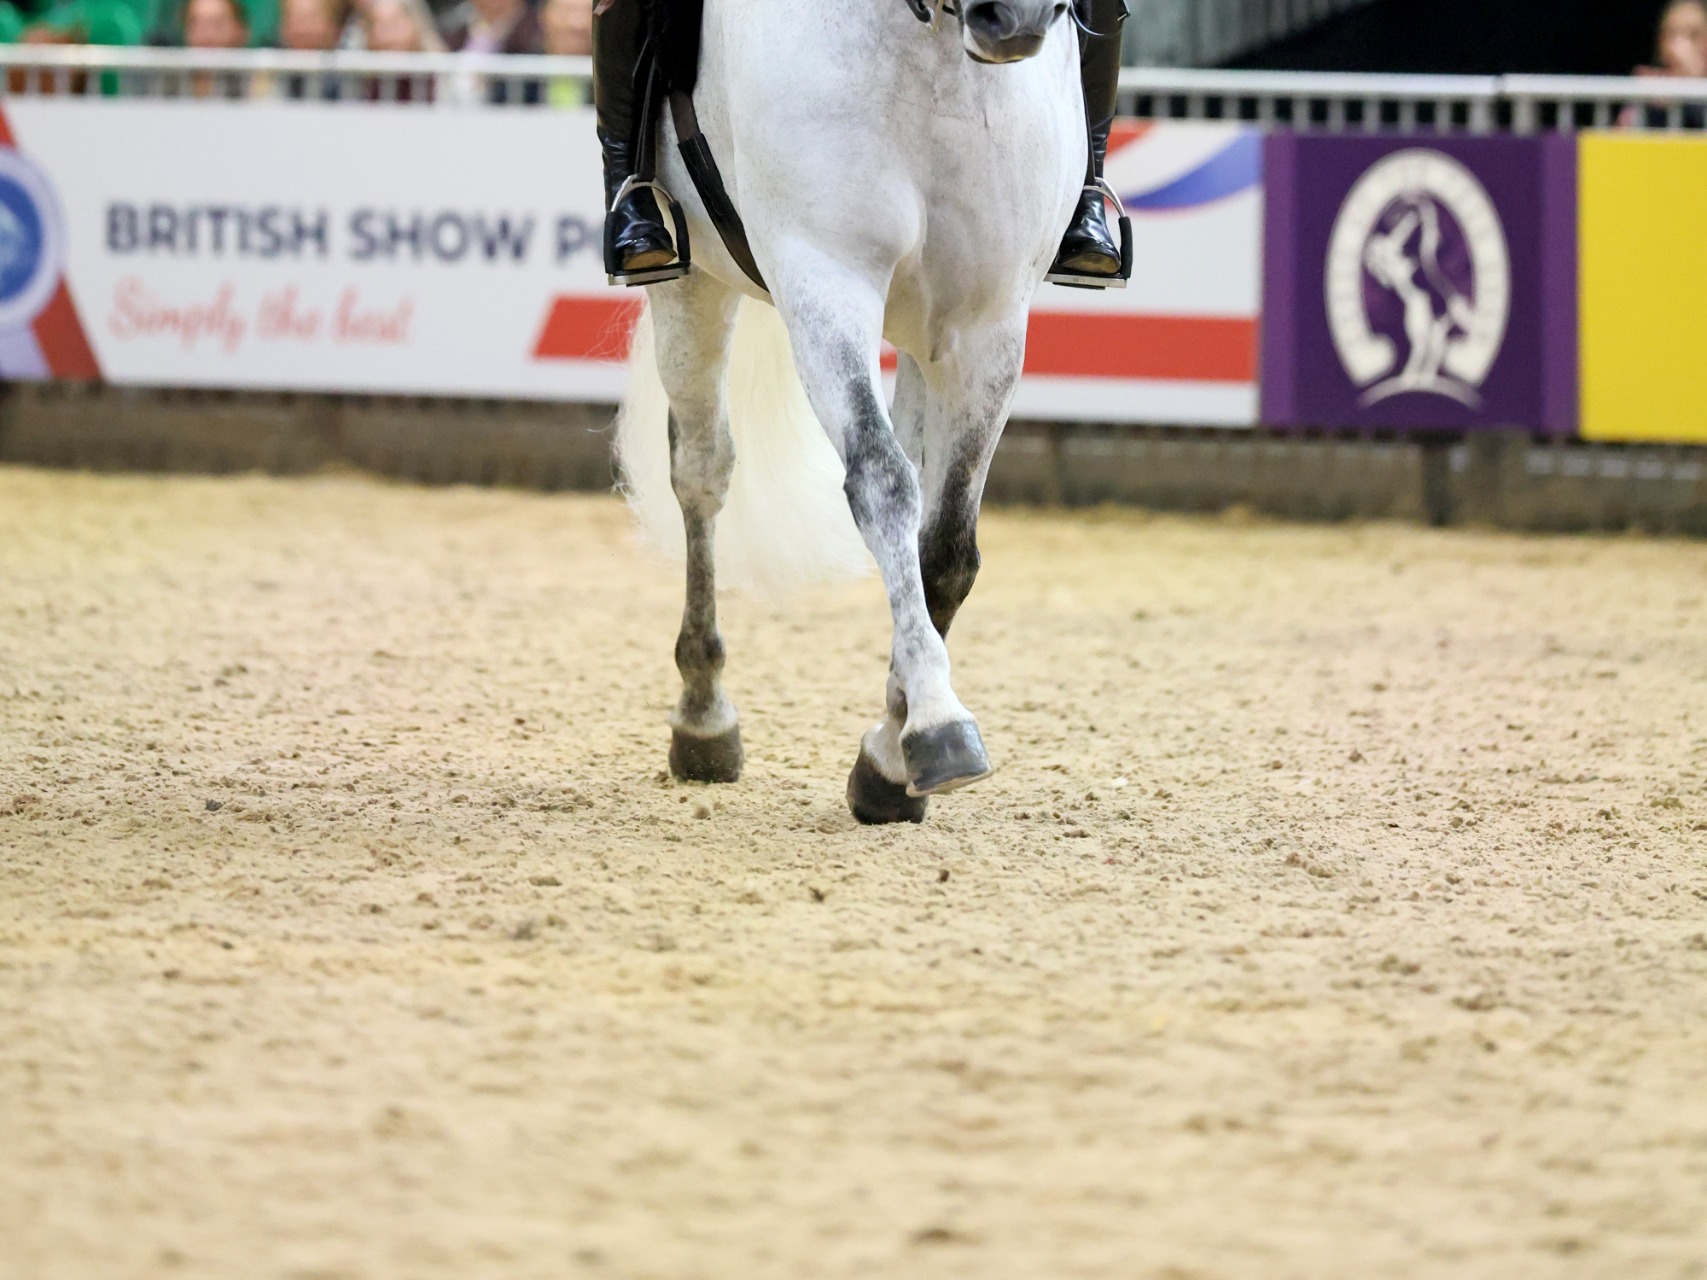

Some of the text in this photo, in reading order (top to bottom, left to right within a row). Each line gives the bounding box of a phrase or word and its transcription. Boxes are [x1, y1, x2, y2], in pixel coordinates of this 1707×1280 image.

[105, 201, 604, 265] BRITISH SHOW P
